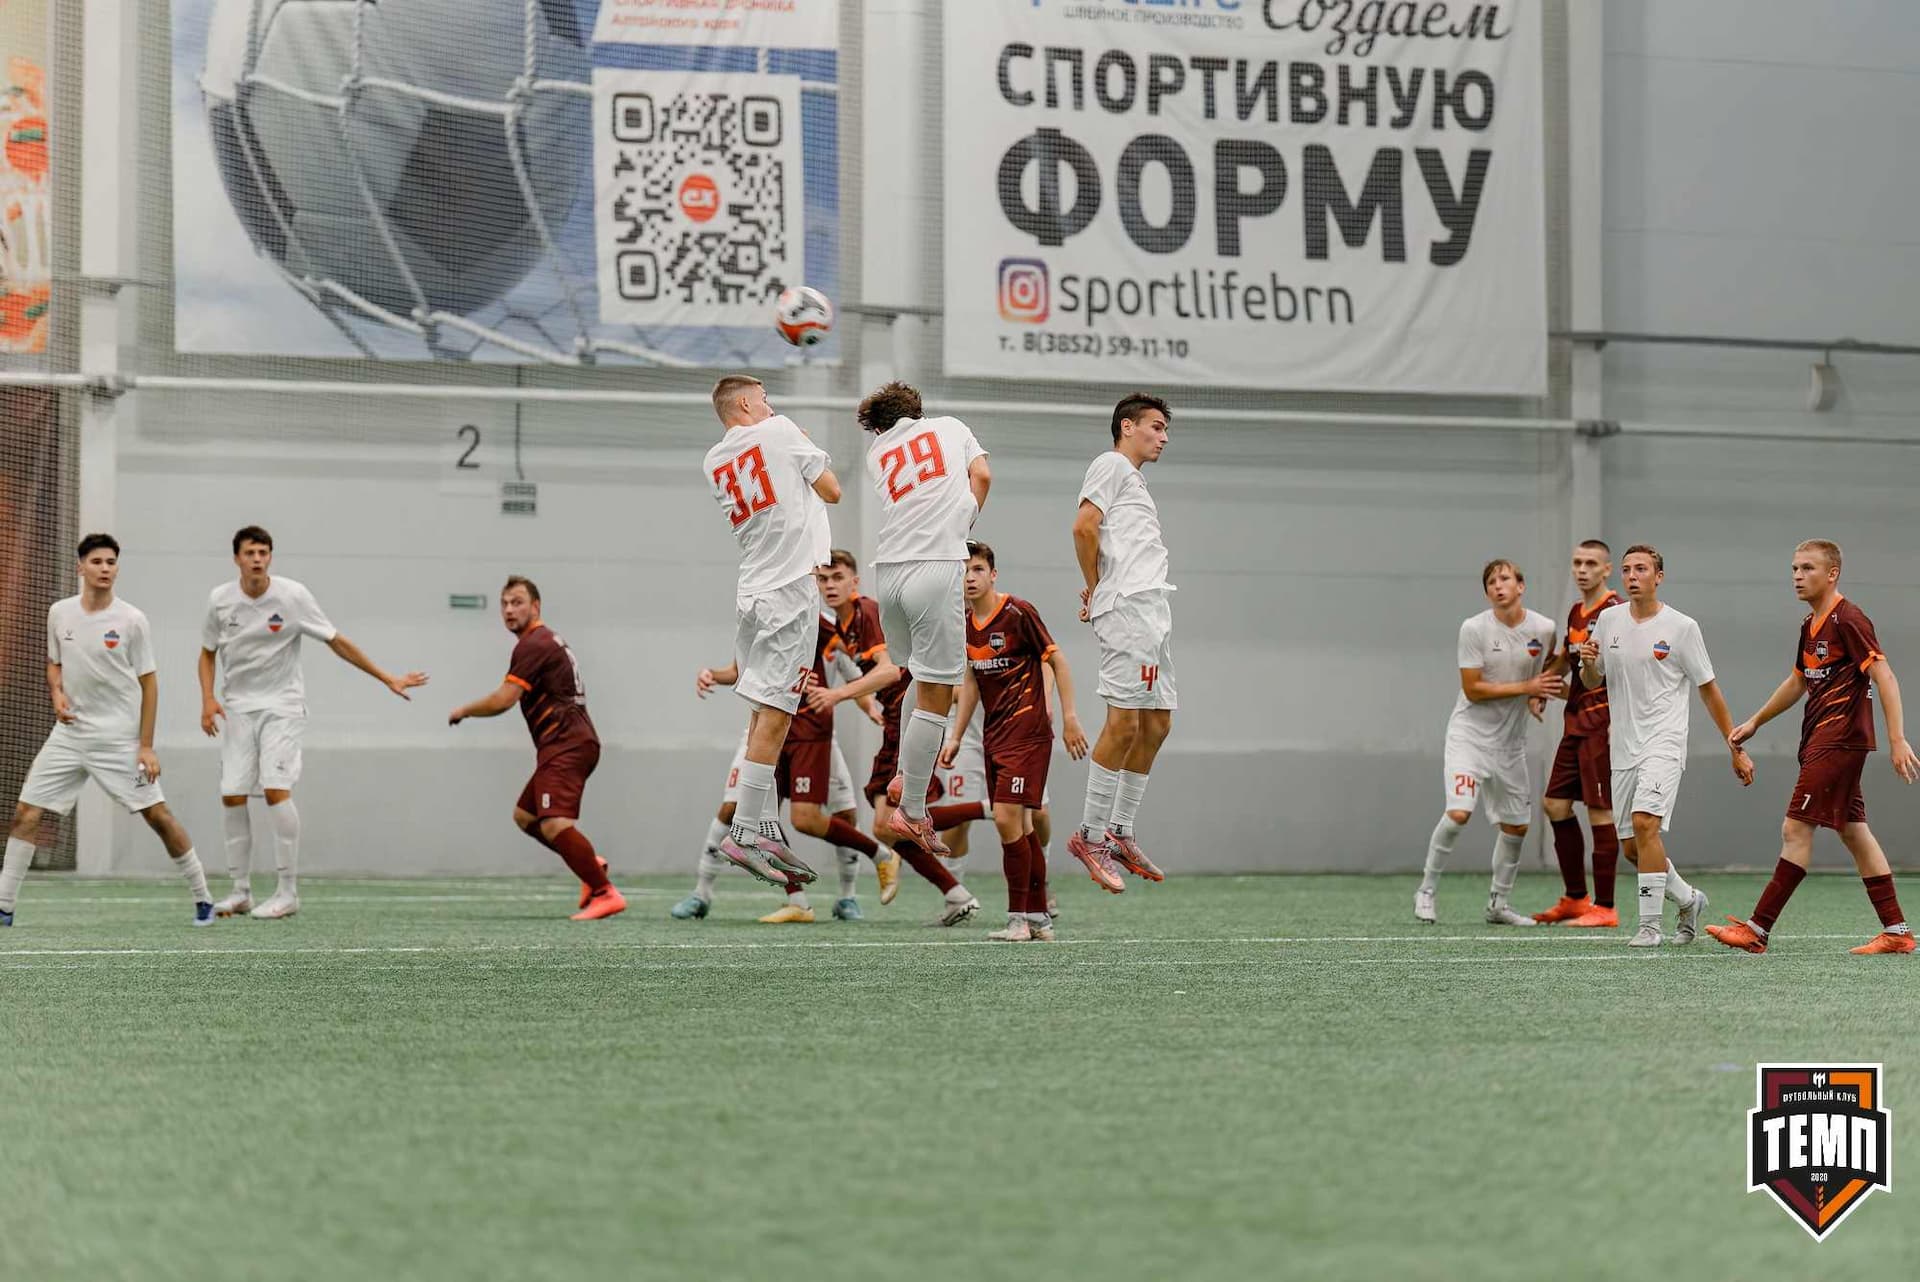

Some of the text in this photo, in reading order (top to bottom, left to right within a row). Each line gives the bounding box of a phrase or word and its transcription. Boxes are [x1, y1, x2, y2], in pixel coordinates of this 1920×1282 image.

[997, 42, 1496, 132] СПОРТИВНУЮ
[996, 127, 1493, 267] ФОРМУ
[1059, 269, 1354, 327] sportlifebrn
[1023, 331, 1102, 358] 8(3852)
[1107, 335, 1190, 359] 59-11-10
[456, 424, 481, 469] 2
[879, 430, 949, 504] 29
[713, 443, 779, 529] 33
[795, 777, 811, 793] 33
[1011, 776, 1024, 794] 21
[1455, 775, 1475, 797] 24
[1801, 794, 1811, 810] 7
